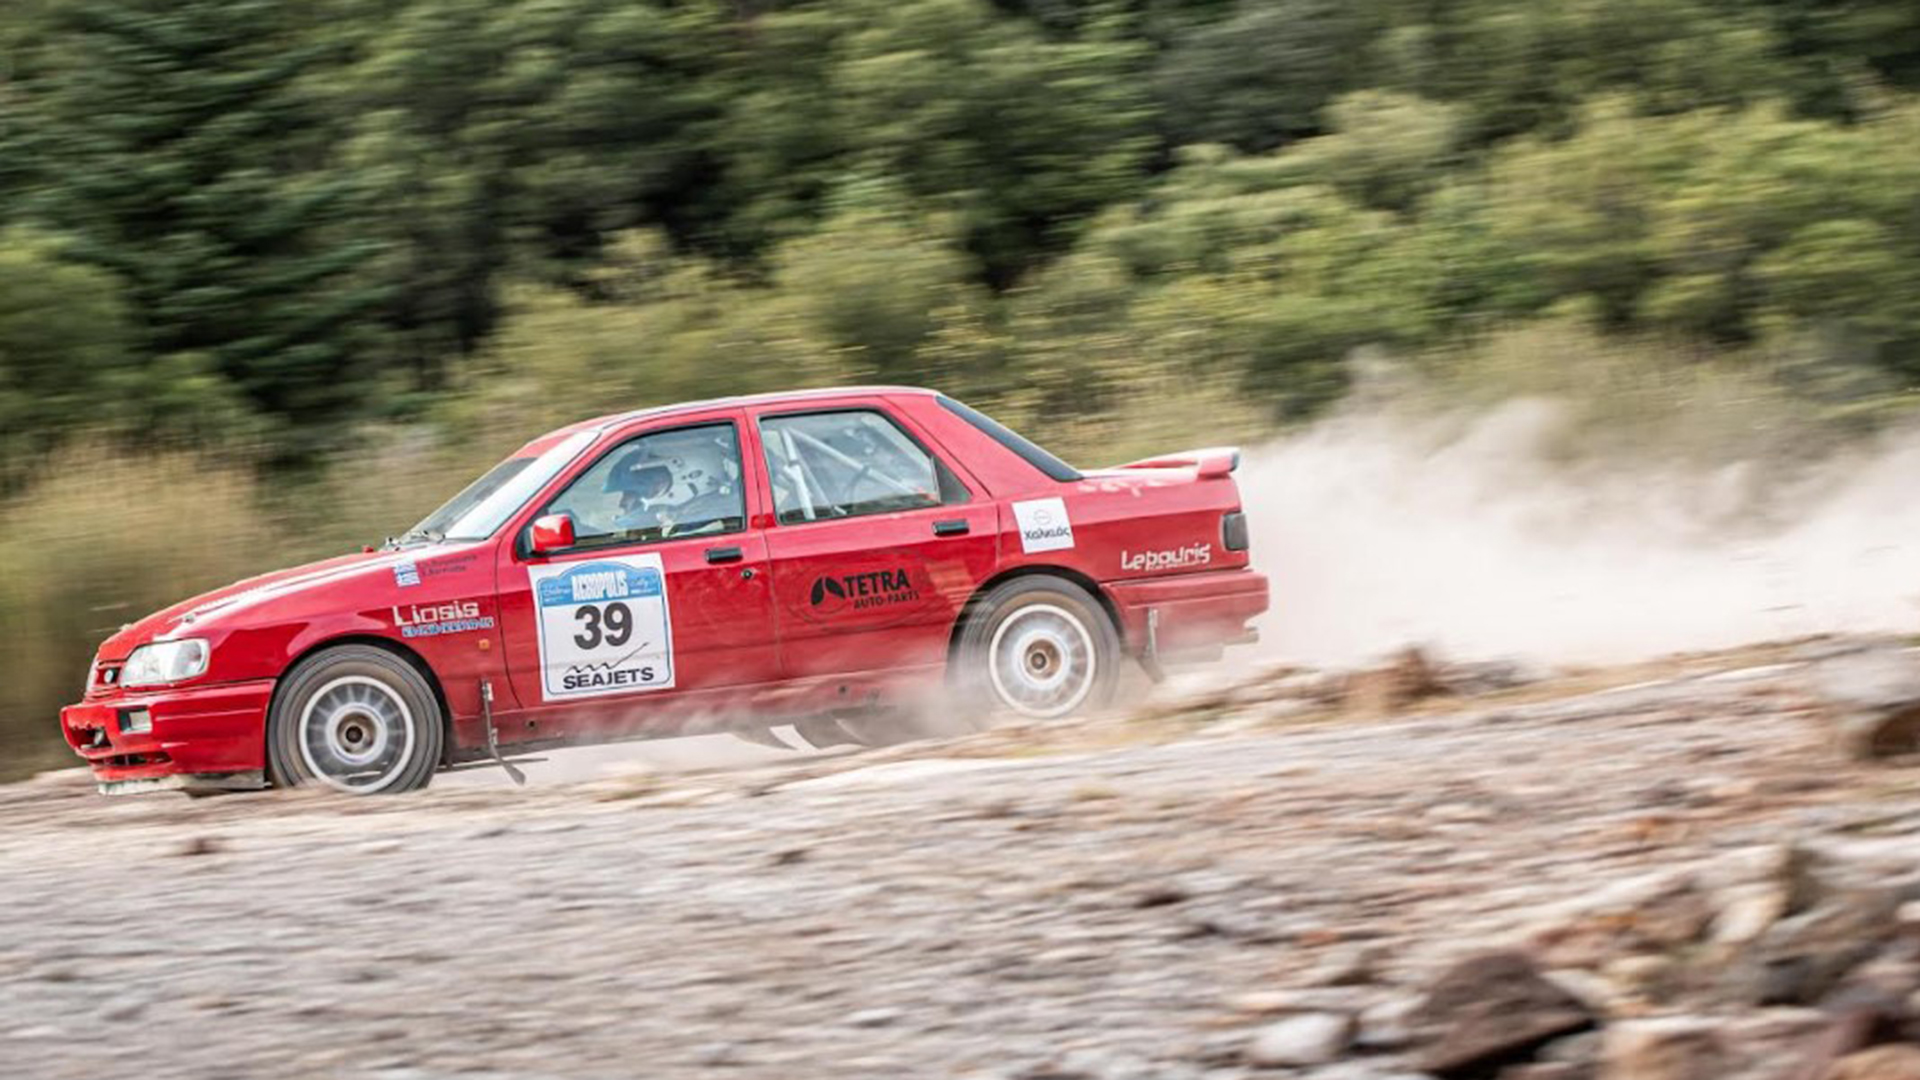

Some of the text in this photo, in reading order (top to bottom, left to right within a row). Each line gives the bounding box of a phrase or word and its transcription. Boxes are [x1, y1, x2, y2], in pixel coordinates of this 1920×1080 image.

[843, 569, 910, 597] TETRA
[393, 600, 480, 626] Liosis
[573, 602, 633, 650] 39
[563, 667, 654, 690] SEAJETS
